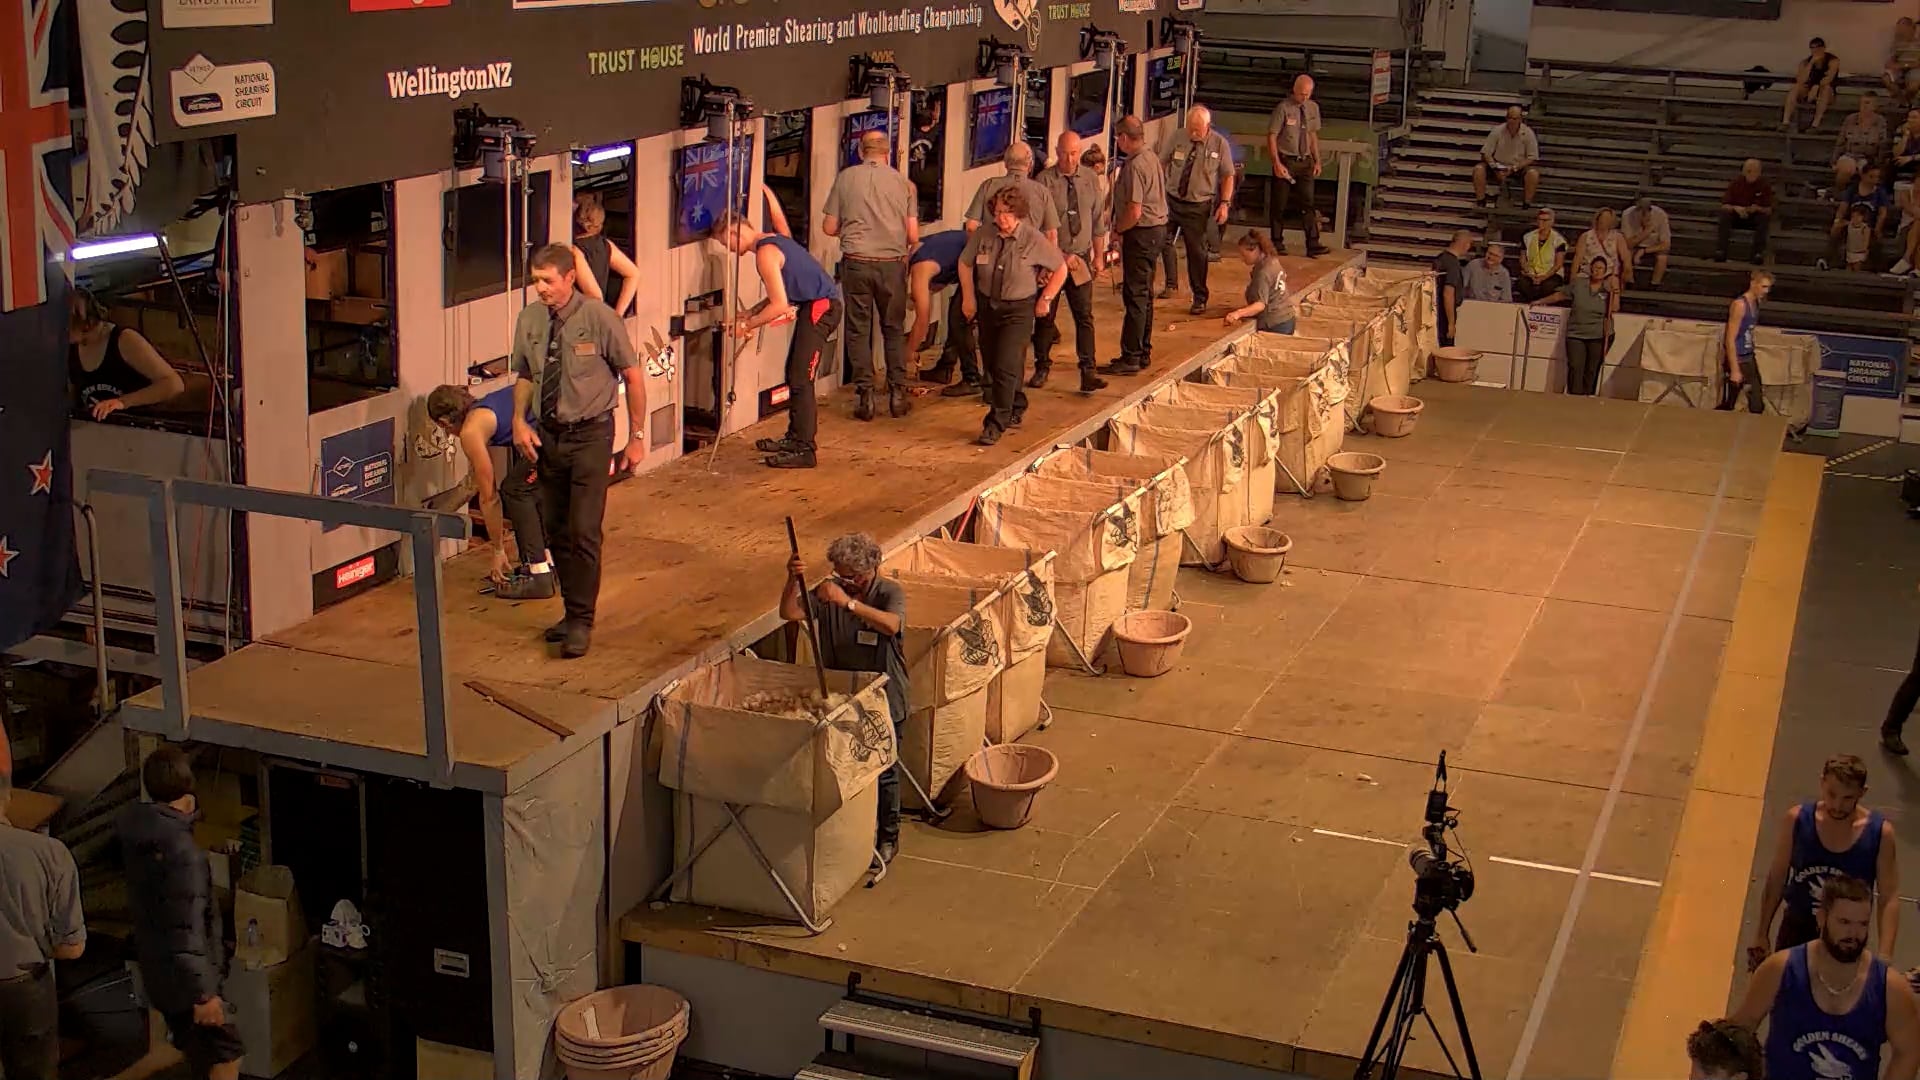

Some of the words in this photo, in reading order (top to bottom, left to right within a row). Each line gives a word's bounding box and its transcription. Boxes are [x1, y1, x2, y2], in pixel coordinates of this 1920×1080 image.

[1048, 4, 1069, 19] TRUST
[694, 25, 731, 54] World
[736, 21, 781, 49] Premier
[785, 16, 834, 44] Shearing
[837, 13, 855, 38] and
[858, 8, 921, 34] Woolhandling
[924, 2, 982, 30] Championship
[588, 49, 635, 75] TRUST
[640, 44, 684, 69] HOUSE
[234, 72, 269, 84] NATIONAL
[387, 61, 512, 99] WellingtonNZ
[234, 84, 270, 97] SHEARING
[235, 97, 263, 109] CIRCUIT
[1848, 359, 1890, 369] NATIONAL
[1848, 367, 1890, 378] SHEARING
[1847, 375, 1880, 385] CIRCUIT
[1794, 865, 1829, 883] GOLDEN
[1792, 1030, 1830, 1053] GOLDEN
[1831, 1031, 1868, 1061] SHEARS
